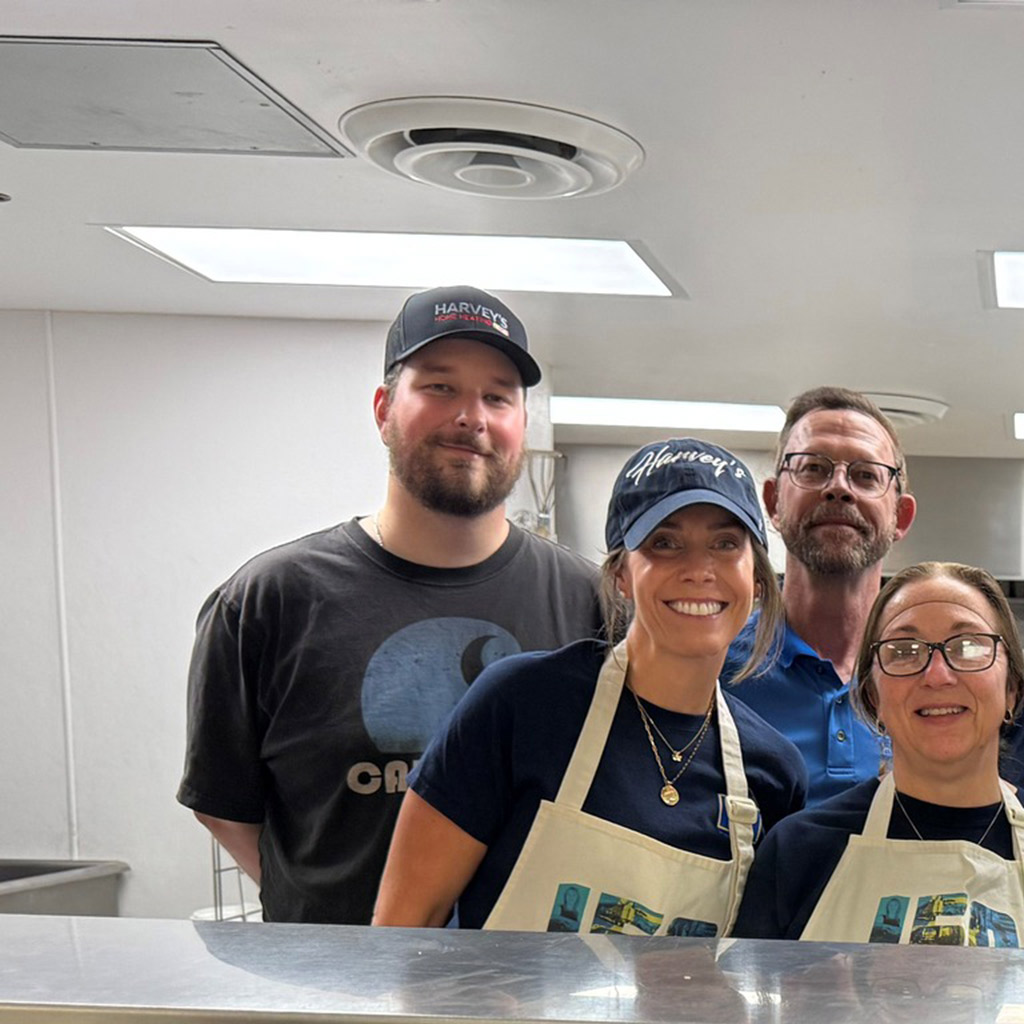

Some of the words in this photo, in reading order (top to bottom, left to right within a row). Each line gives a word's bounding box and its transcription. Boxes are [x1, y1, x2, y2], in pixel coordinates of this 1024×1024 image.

[434, 302, 509, 329] HARVEY'S
[626, 445, 746, 486] Harvey's
[346, 760, 420, 795] CA
